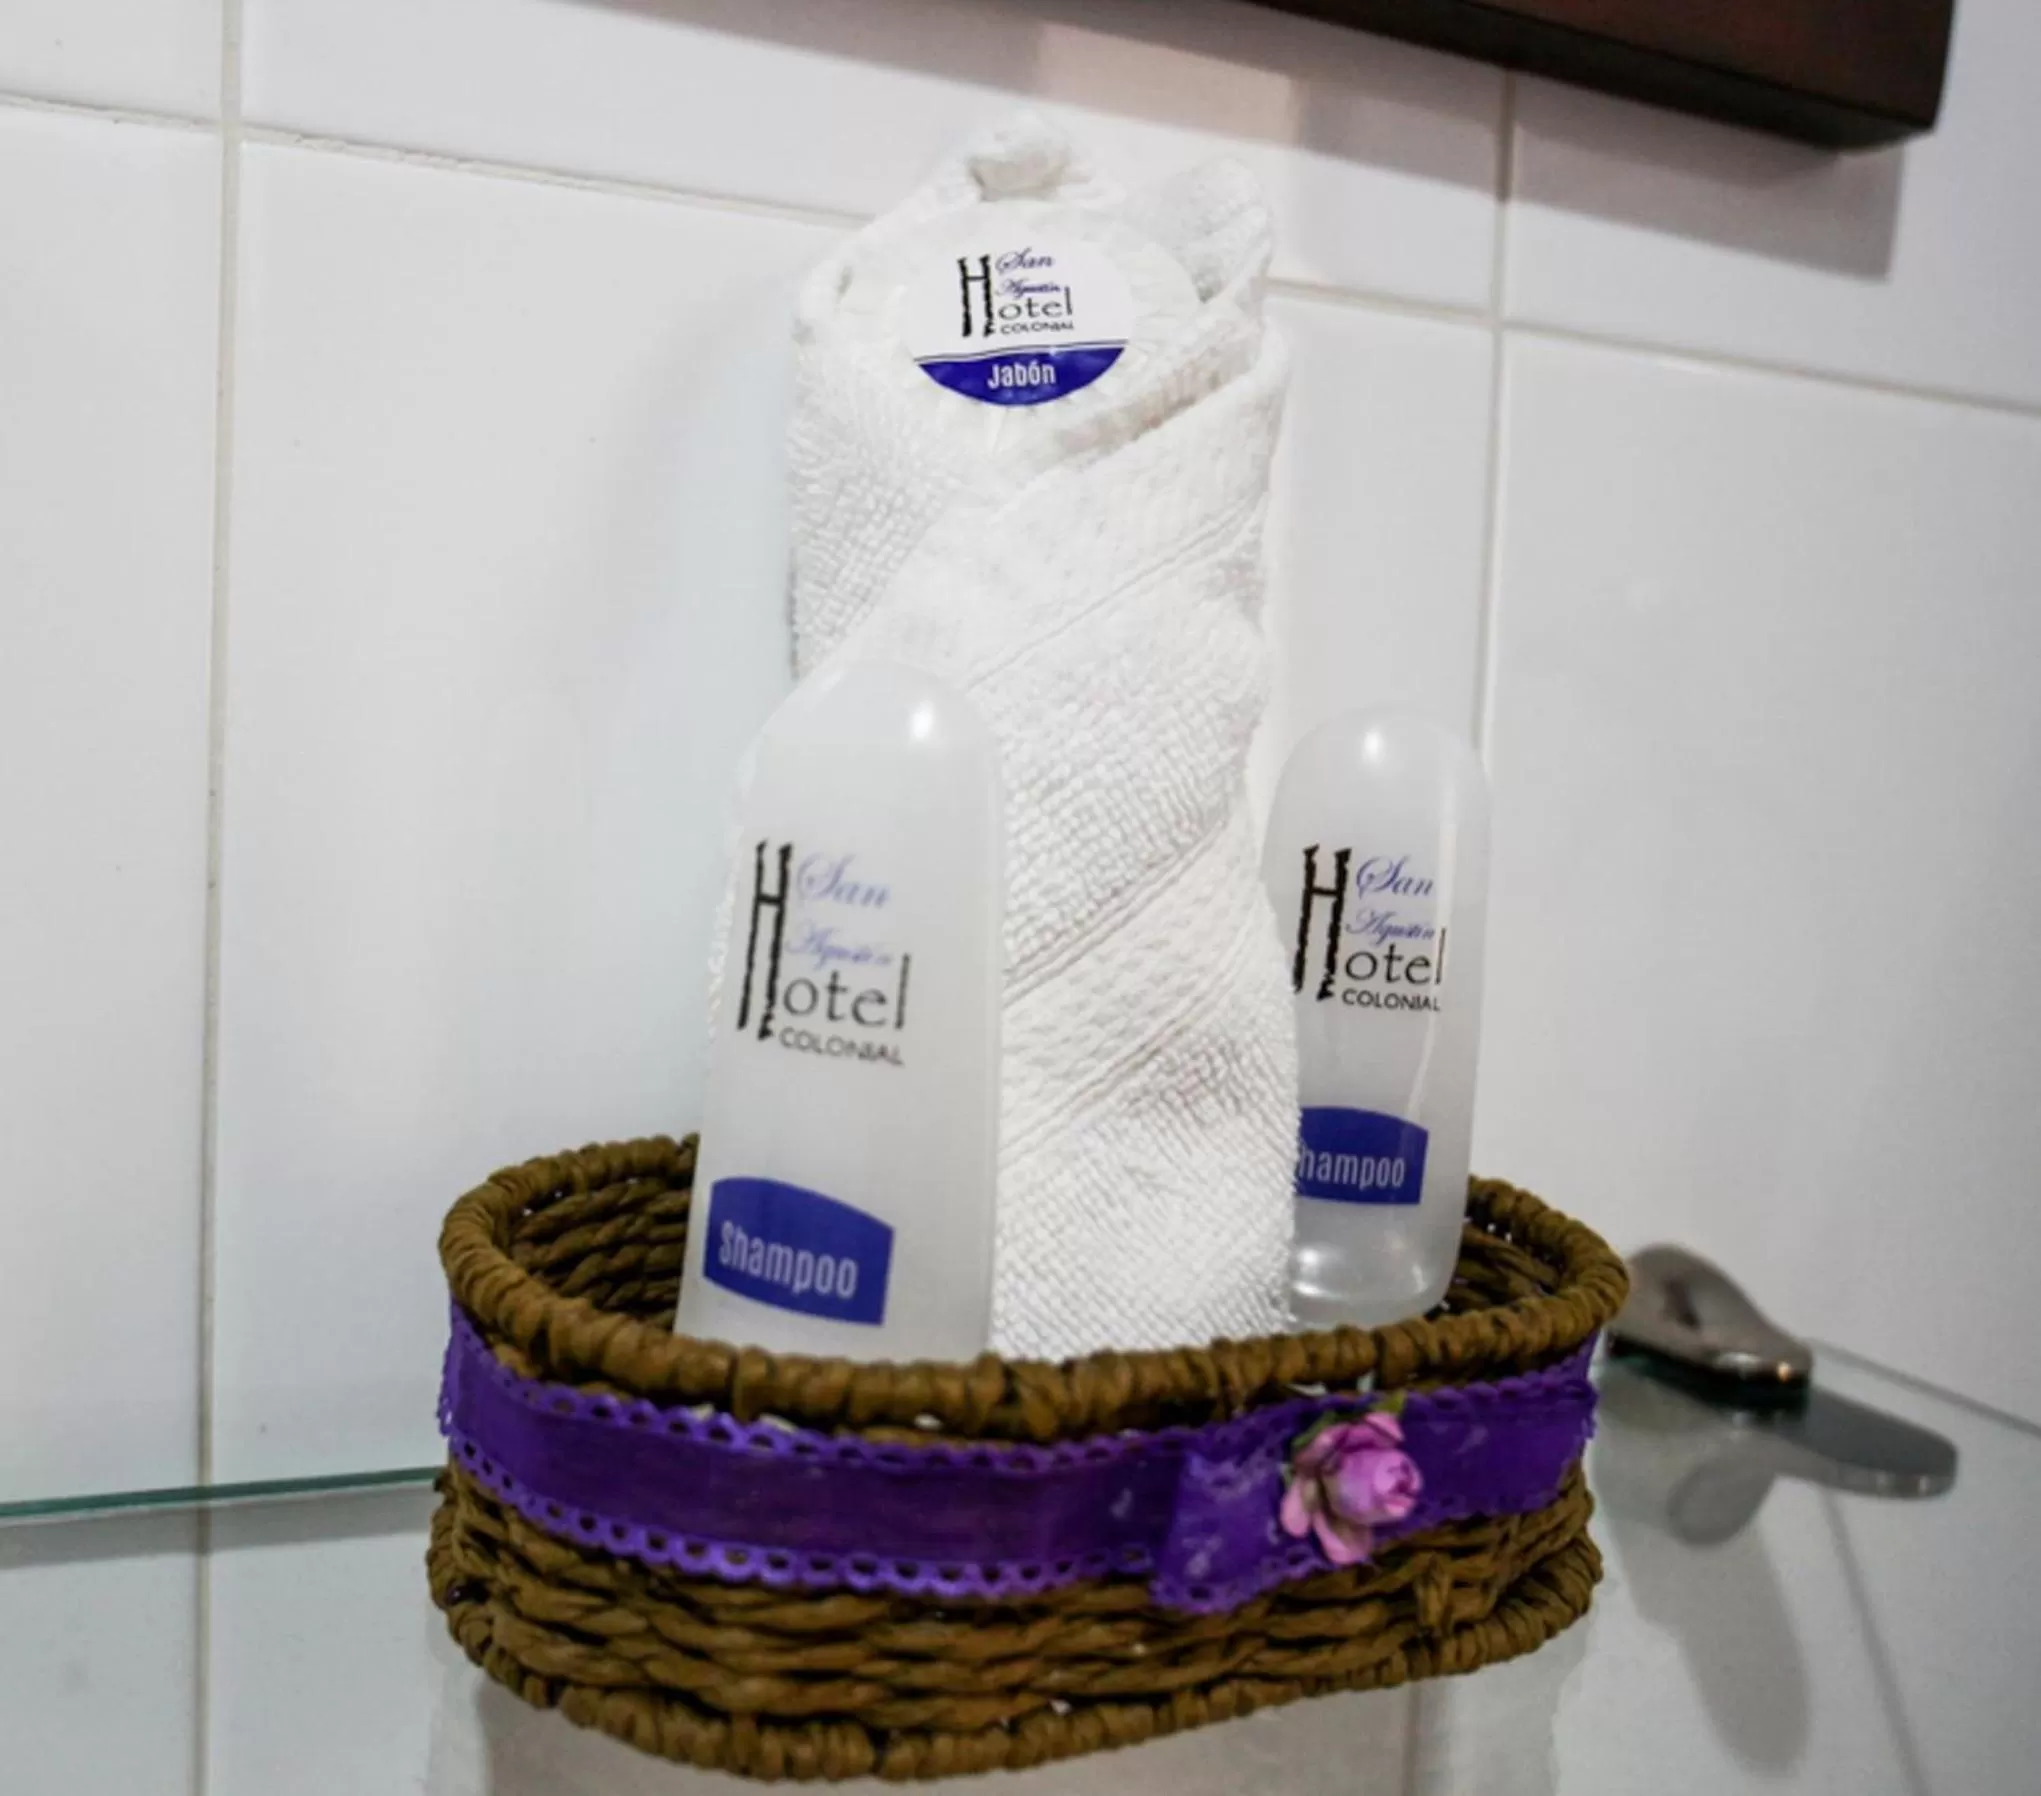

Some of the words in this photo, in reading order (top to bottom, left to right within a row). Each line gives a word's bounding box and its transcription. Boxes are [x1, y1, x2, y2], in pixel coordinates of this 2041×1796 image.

[995, 248, 1054, 273] San
[957, 254, 1073, 338] Hotel
[1000, 322, 1074, 335] COLONIAL
[987, 360, 1056, 389] Jabón
[797, 852, 891, 908] San
[1356, 855, 1434, 899] San
[737, 838, 910, 1041] Hotel
[1293, 843, 1446, 1002] Hotel
[1341, 988, 1441, 1012] COLONIAL
[779, 1026, 905, 1067] COLONIAL
[1298, 1138, 1406, 1191] hampoo
[719, 1220, 858, 1299] Shampoo
